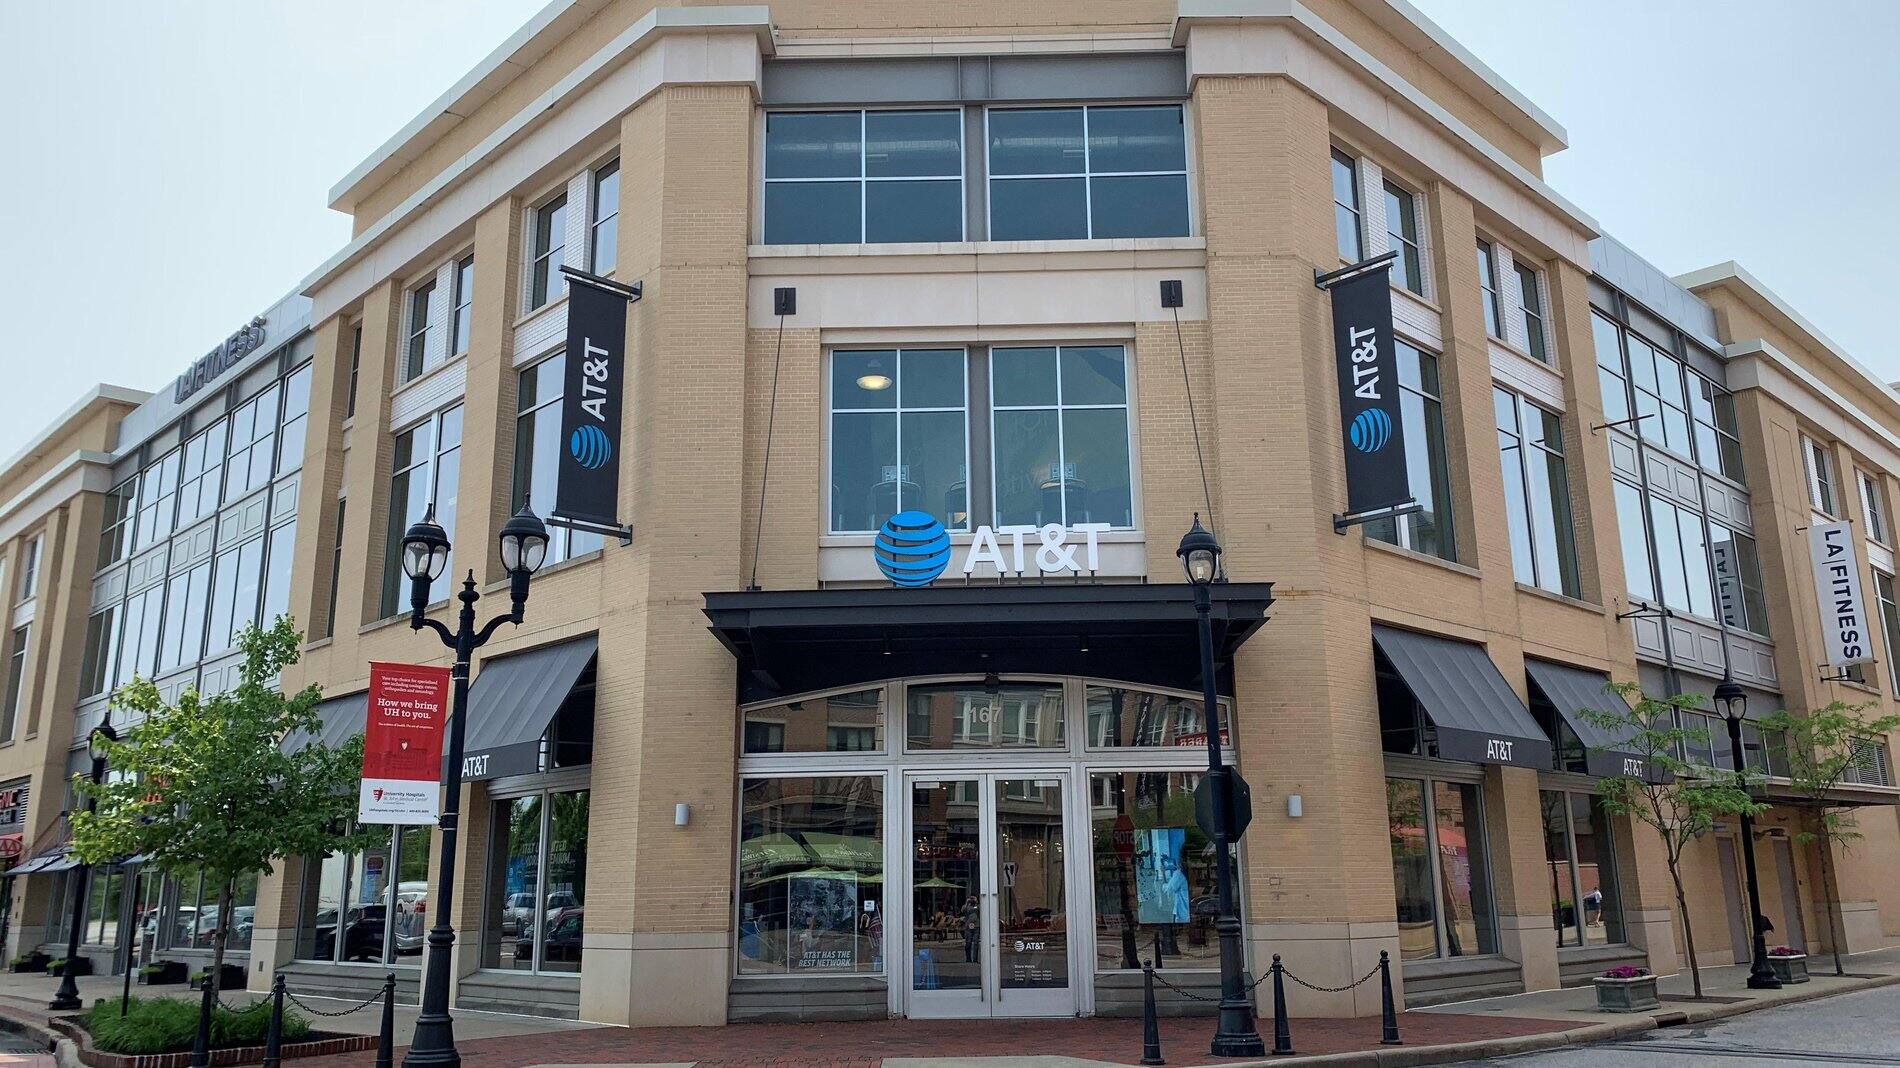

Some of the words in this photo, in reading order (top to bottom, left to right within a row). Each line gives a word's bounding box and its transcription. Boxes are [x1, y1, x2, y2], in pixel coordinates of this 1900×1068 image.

[1349, 326, 1381, 399] AT&T
[581, 336, 609, 422] AT&T
[963, 523, 1111, 573] AT&T
[1830, 564, 1862, 659] FITNESS
[377, 698, 399, 707] How
[414, 700, 438, 712] bring
[384, 708, 400, 717] UH
[401, 710, 411, 718] to
[412, 711, 431, 720] you.
[969, 706, 1001, 723] 167
[1487, 739, 1512, 761] AT&T
[461, 755, 489, 778] AT&T
[1623, 758, 1643, 778] AT&T
[803, 951, 821, 959] AT&T
[837, 950, 851, 958] THE
[1025, 942, 1045, 950] AT&T
[799, 959, 815, 967] BEST
[816, 959, 851, 967] NETWORK
